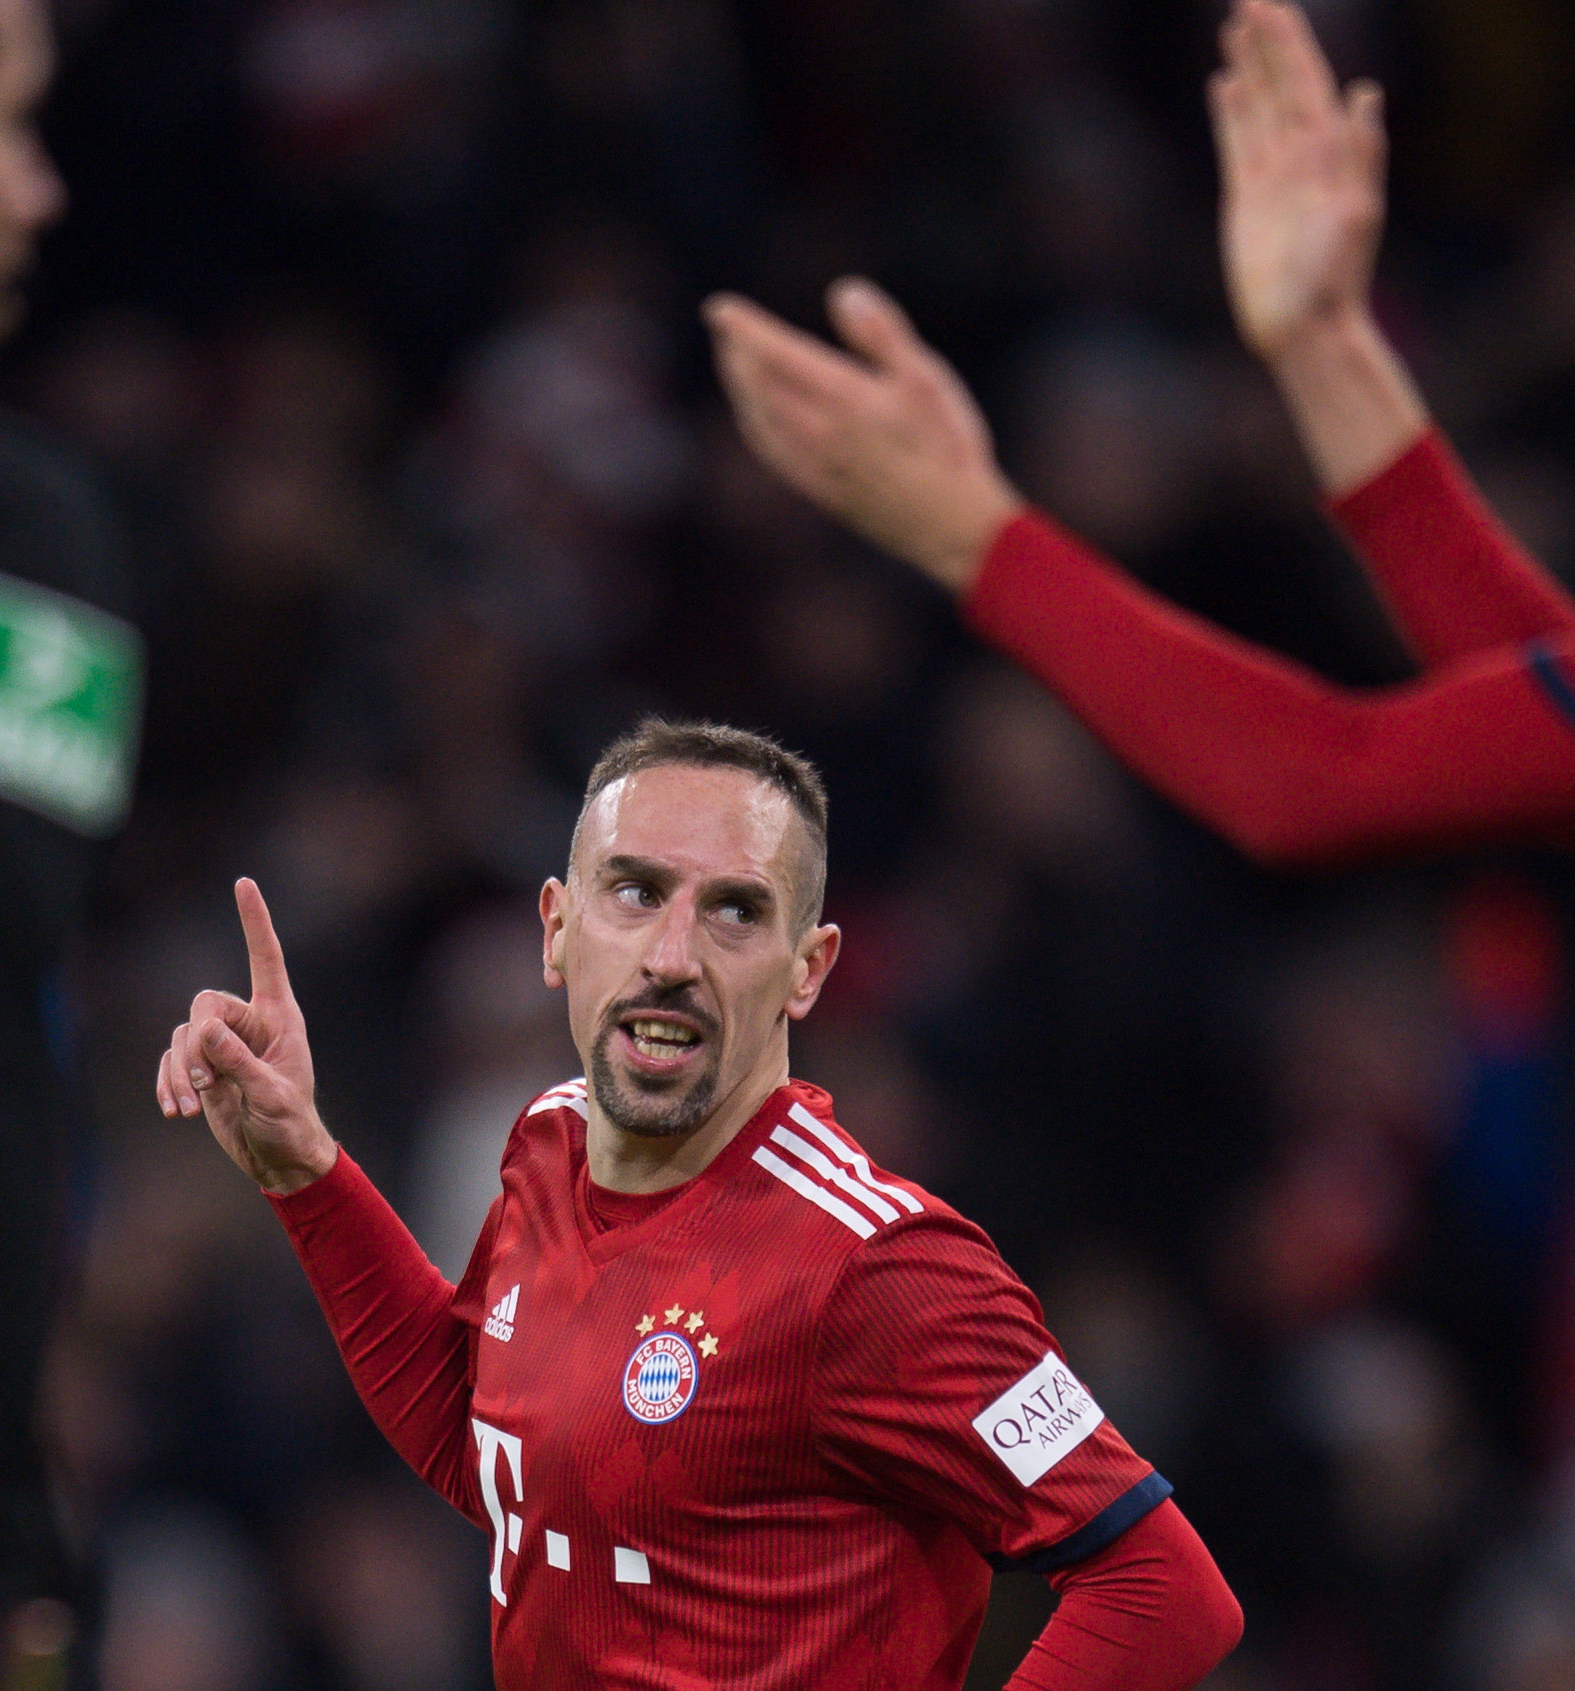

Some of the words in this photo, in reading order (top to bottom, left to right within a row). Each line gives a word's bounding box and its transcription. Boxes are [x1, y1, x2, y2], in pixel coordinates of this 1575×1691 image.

[484, 1316, 515, 1343] adidas
[636, 1344, 653, 1366] FC
[655, 1339, 692, 1380] BAYERN
[992, 1368, 1078, 1449] QATAR
